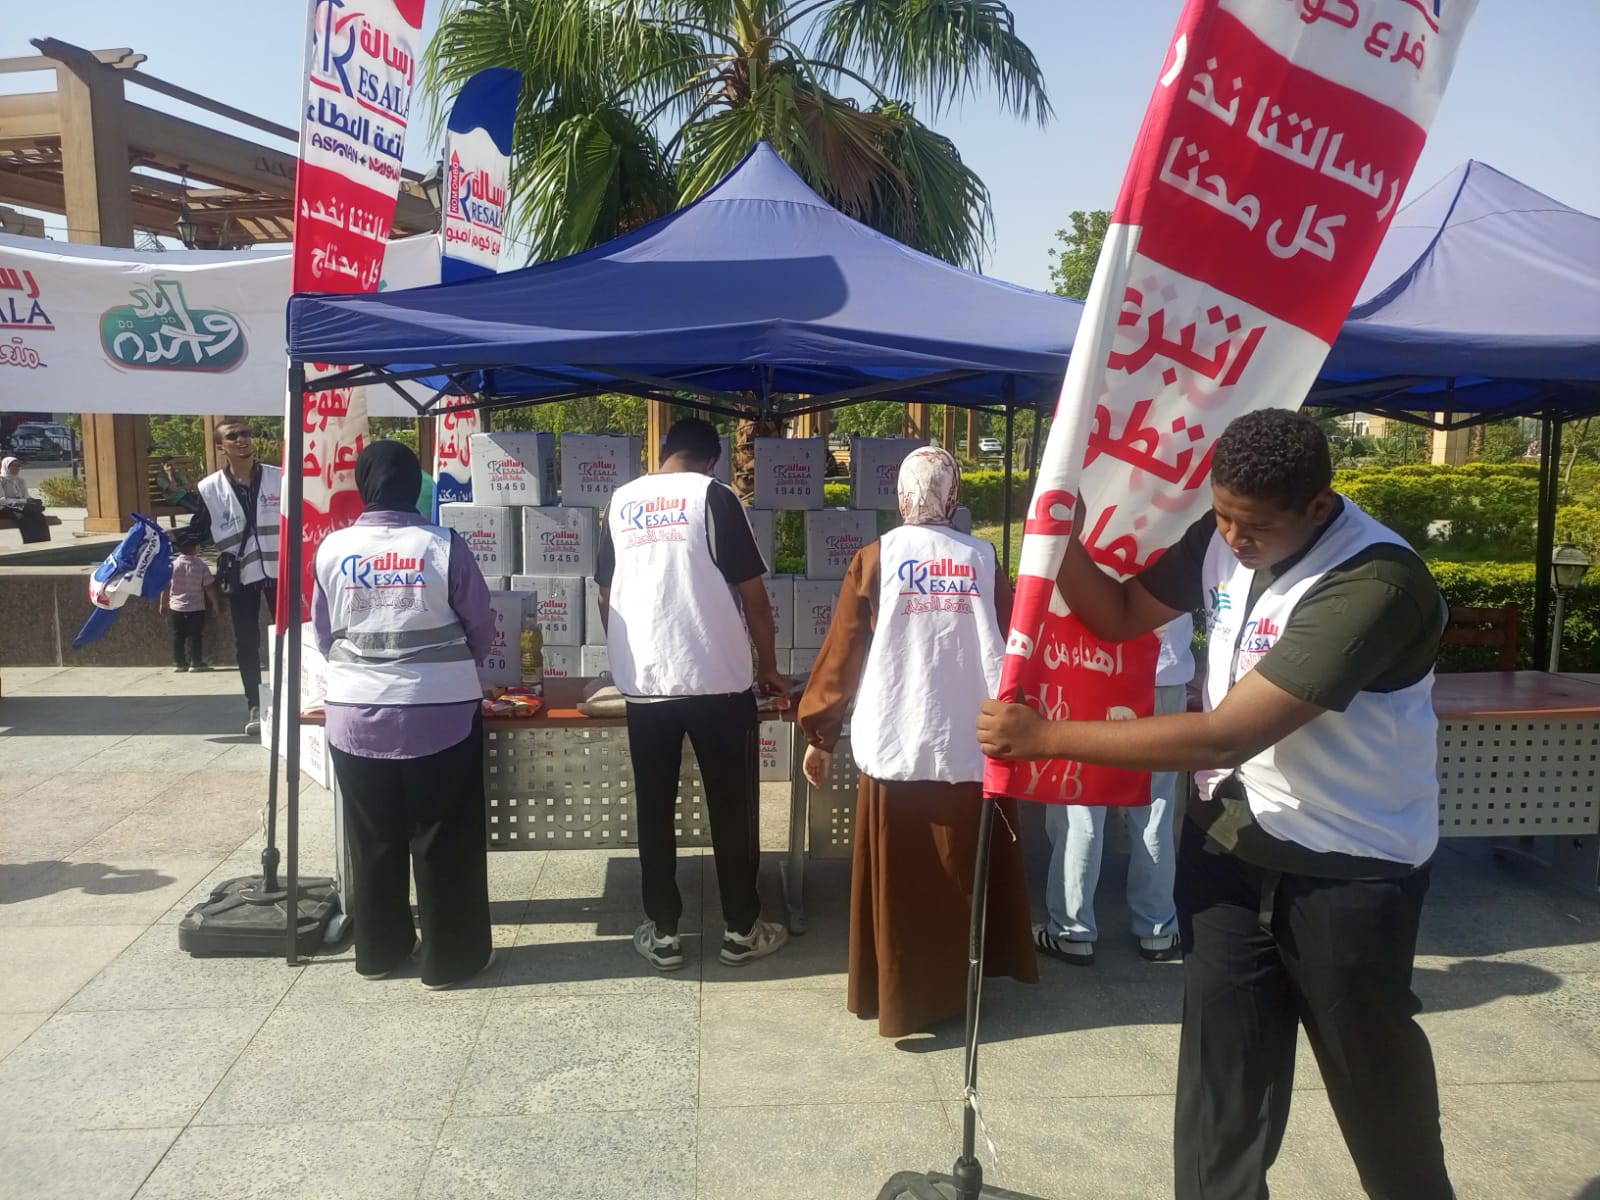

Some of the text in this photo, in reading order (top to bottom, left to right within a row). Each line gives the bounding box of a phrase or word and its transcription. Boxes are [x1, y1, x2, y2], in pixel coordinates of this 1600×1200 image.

[361, 20, 415, 87] رسالة
[373, 124, 404, 162] تعة
[1246, 96, 1400, 223] رسالتنا
[1158, 136, 1347, 262] كل محتا
[1083, 398, 1222, 491] اتطو
[490, 482, 526, 491] 19450
[620, 500, 688, 530] RESALA
[645, 496, 687, 512] رسالة
[341, 554, 426, 589] RESALA
[373, 552, 425, 574] رسالة
[475, 553, 497, 562] 450
[543, 554, 580, 563] 19450
[930, 558, 977, 582] رسالة
[898, 559, 980, 595] RESALA
[538, 623, 568, 632] 450
[1072, 640, 1123, 677] اهداء
